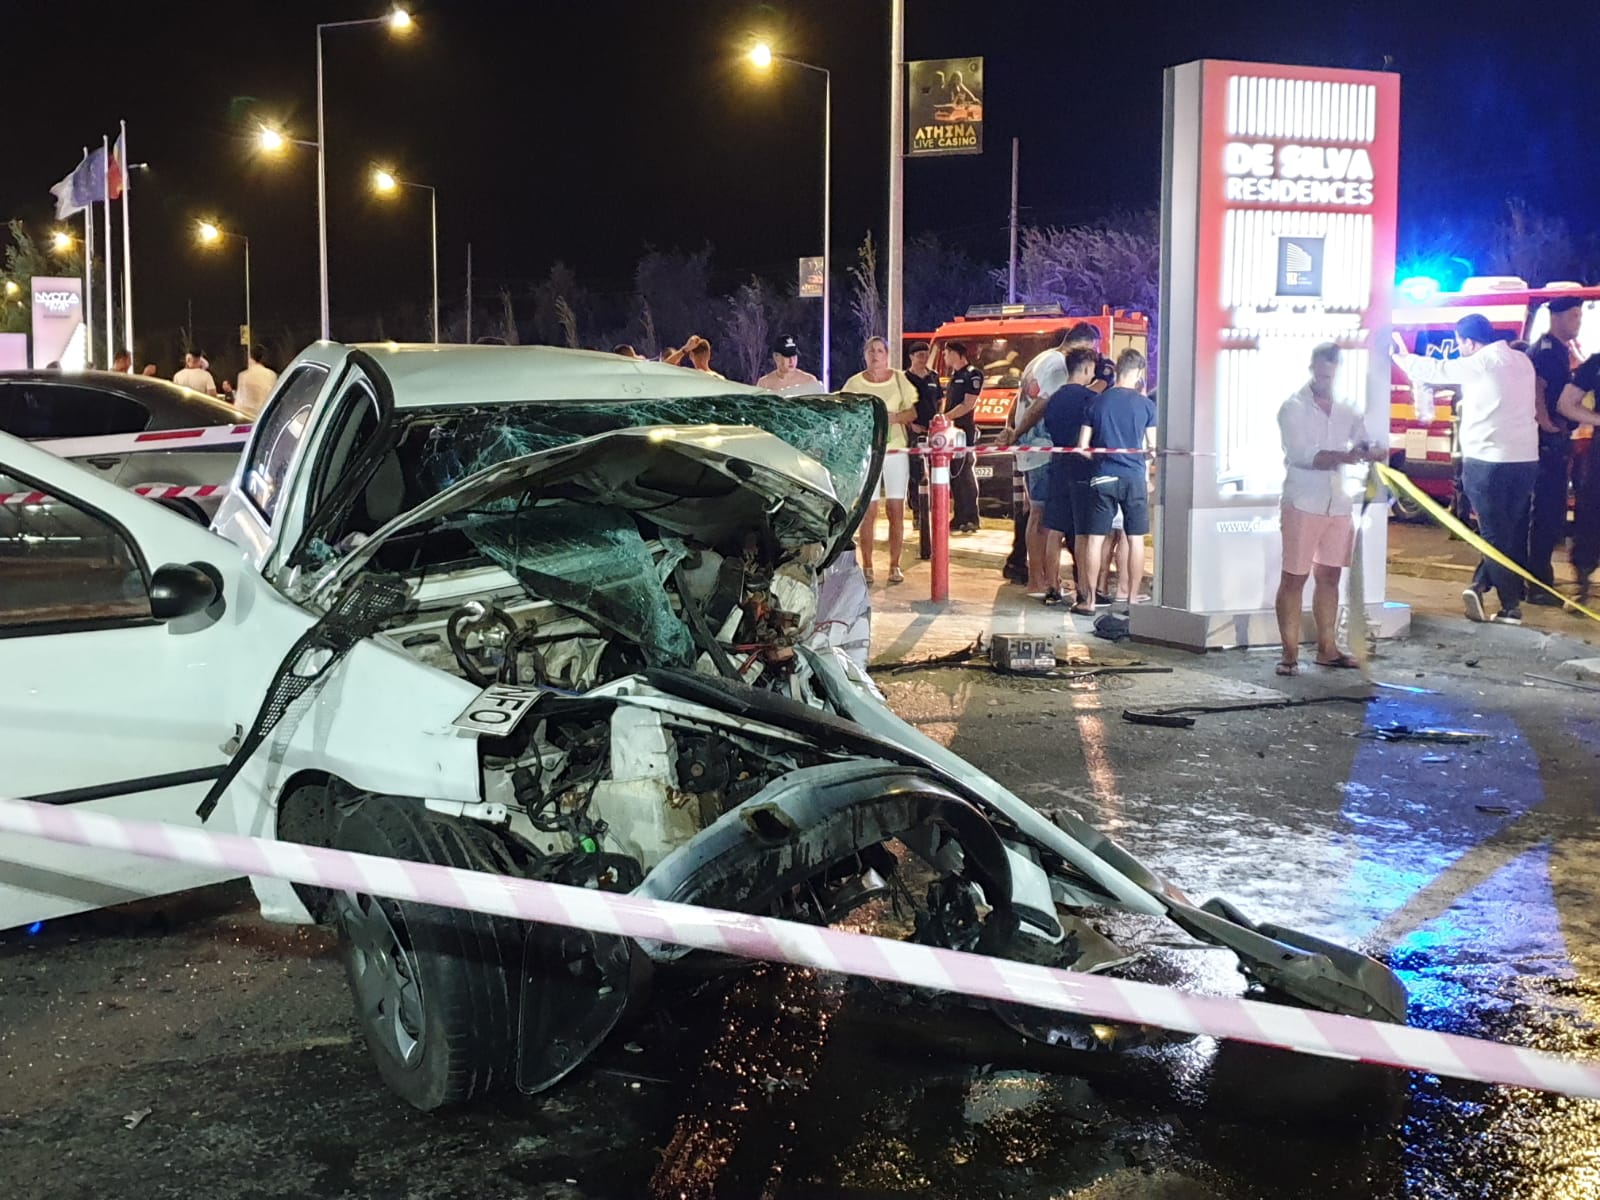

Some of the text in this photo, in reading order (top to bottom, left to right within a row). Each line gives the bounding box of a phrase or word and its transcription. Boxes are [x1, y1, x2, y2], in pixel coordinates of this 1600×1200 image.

[913, 136, 977, 149] LIVE CASINO
[1225, 142, 1374, 181] DE SILVA
[1226, 177, 1374, 205] RESIDENCES
[977, 398, 1011, 407] IER
